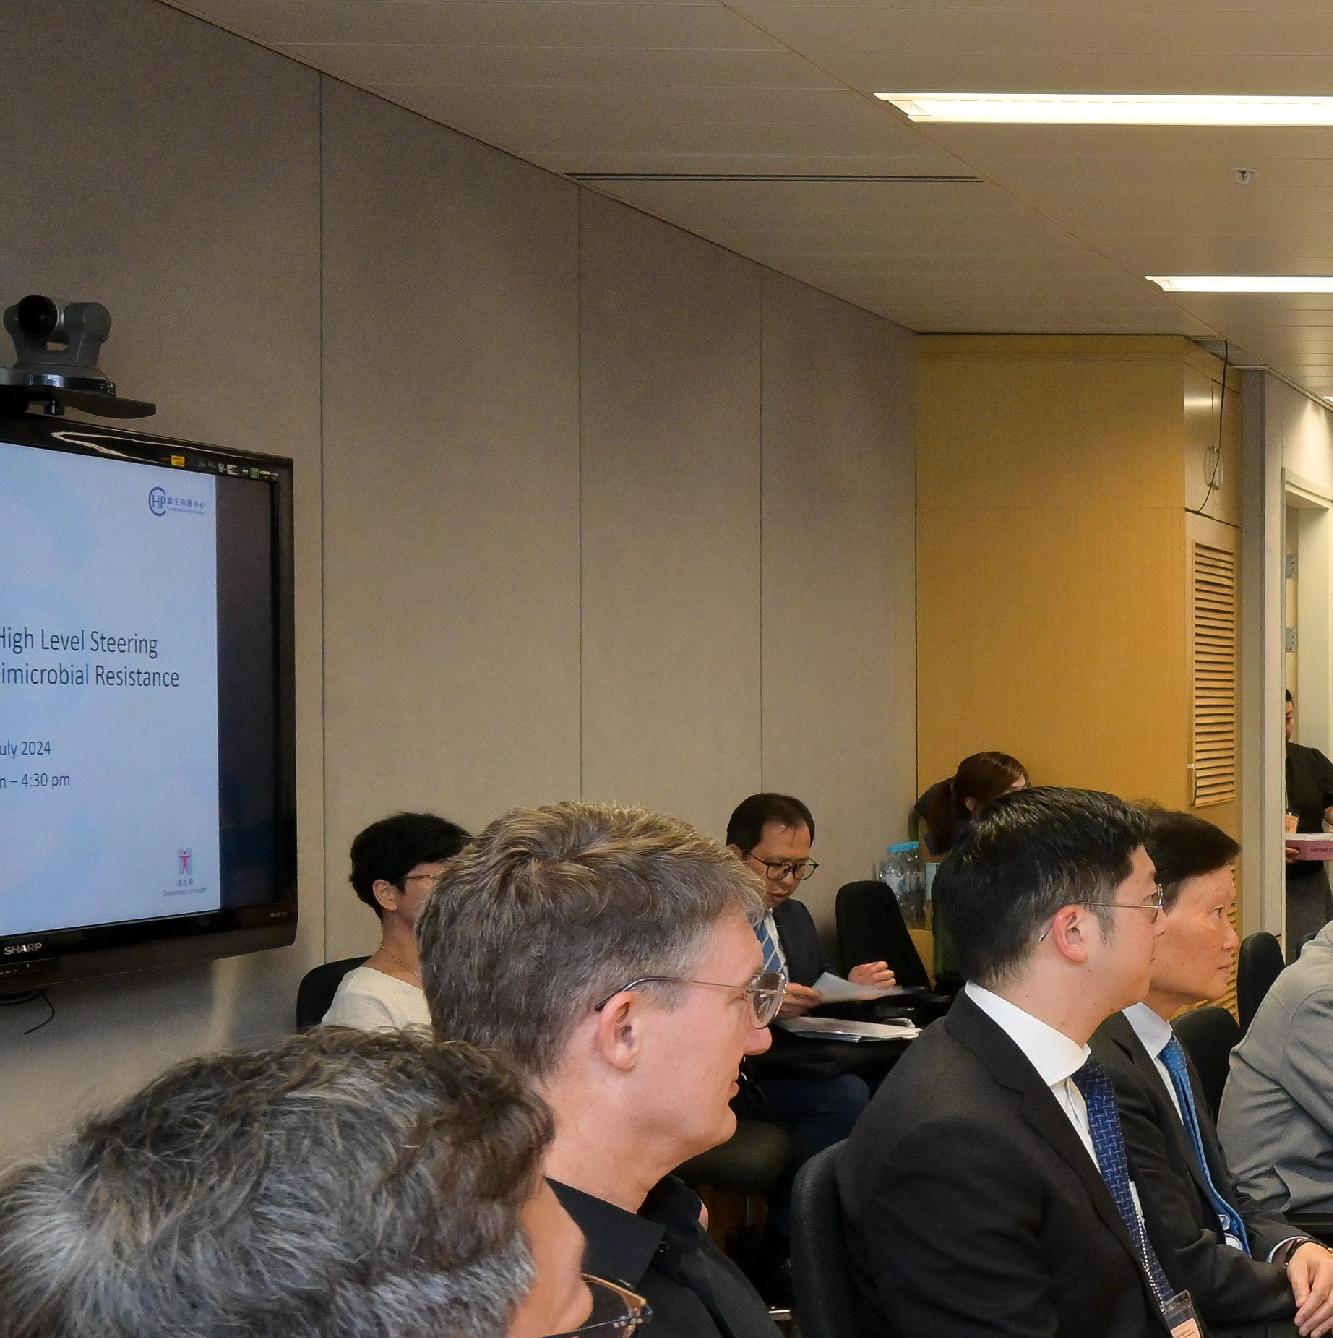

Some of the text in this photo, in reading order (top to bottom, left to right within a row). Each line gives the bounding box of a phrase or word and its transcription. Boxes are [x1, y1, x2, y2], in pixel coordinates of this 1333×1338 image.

[41, 628, 85, 651] Level
[90, 630, 158, 659] Steering
[95, 665, 180, 688] Resistance
[21, 741, 51, 756] 2024
[21, 773, 48, 788] 4:30
[52, 775, 70, 789] pm
[3, 942, 43, 955] SHARP
